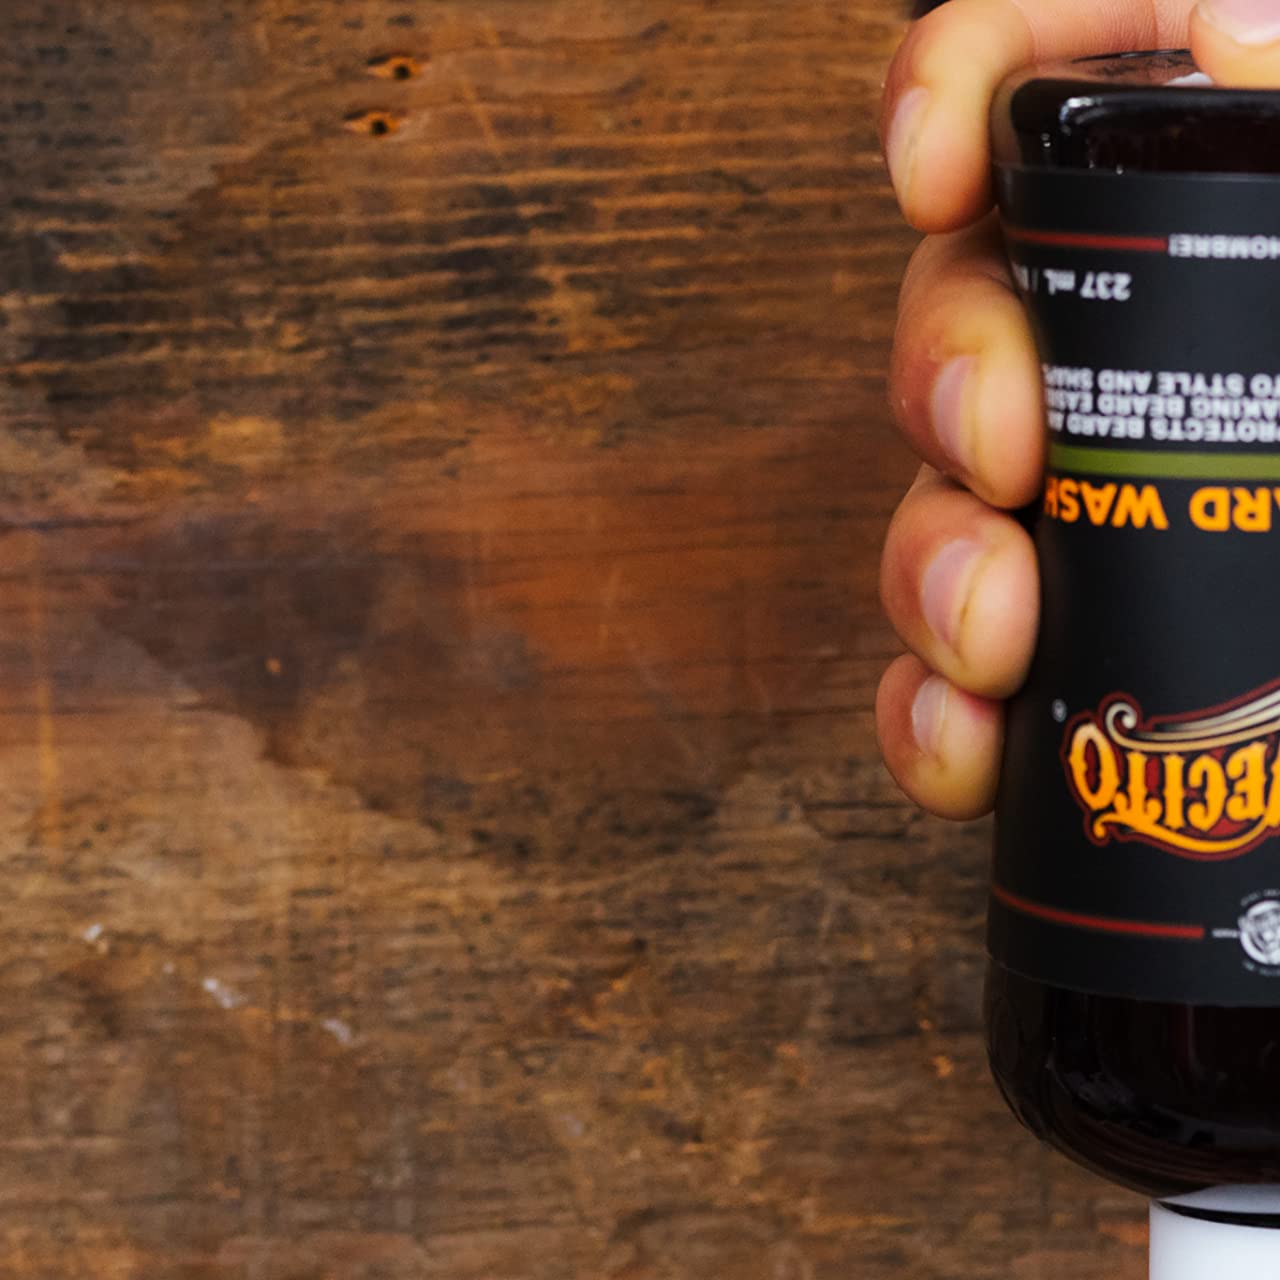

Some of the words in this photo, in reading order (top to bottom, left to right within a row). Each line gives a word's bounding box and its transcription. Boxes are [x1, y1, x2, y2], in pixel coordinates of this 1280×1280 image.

[1080, 271, 1132, 301] 237
[1097, 369, 1152, 394] AND
[1157, 371, 1245, 397] STYLE
[1097, 394, 1185, 418] BEARD
[1066, 412, 1145, 439] BEARD
